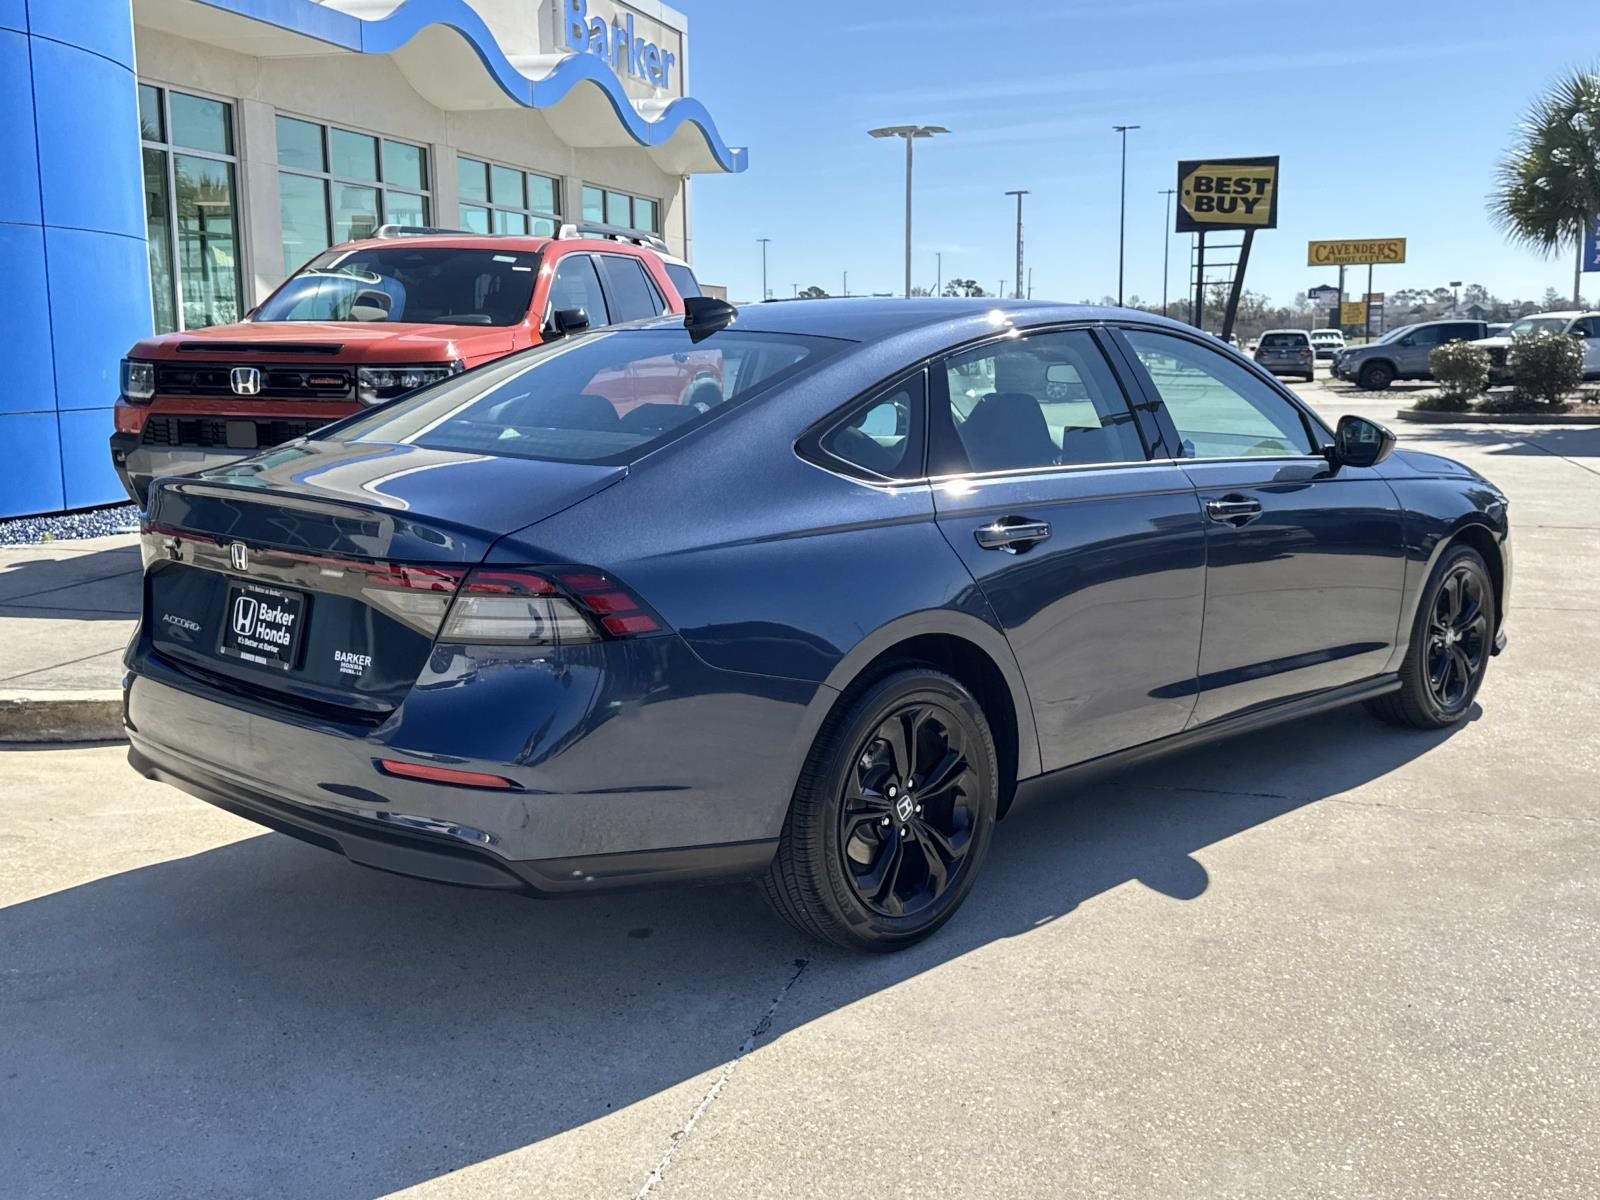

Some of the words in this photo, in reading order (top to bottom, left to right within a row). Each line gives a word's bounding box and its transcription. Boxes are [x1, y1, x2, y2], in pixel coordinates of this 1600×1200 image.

[563, 0, 676, 90] Barker
[1193, 176, 1271, 195] BEST
[1194, 195, 1263, 214] BUY
[1315, 242, 1399, 262] CAVENDER'S
[162, 613, 201, 631] ACCORD
[259, 603, 295, 626] Barker
[255, 621, 290, 646] Honda
[334, 650, 372, 667] BARKER
